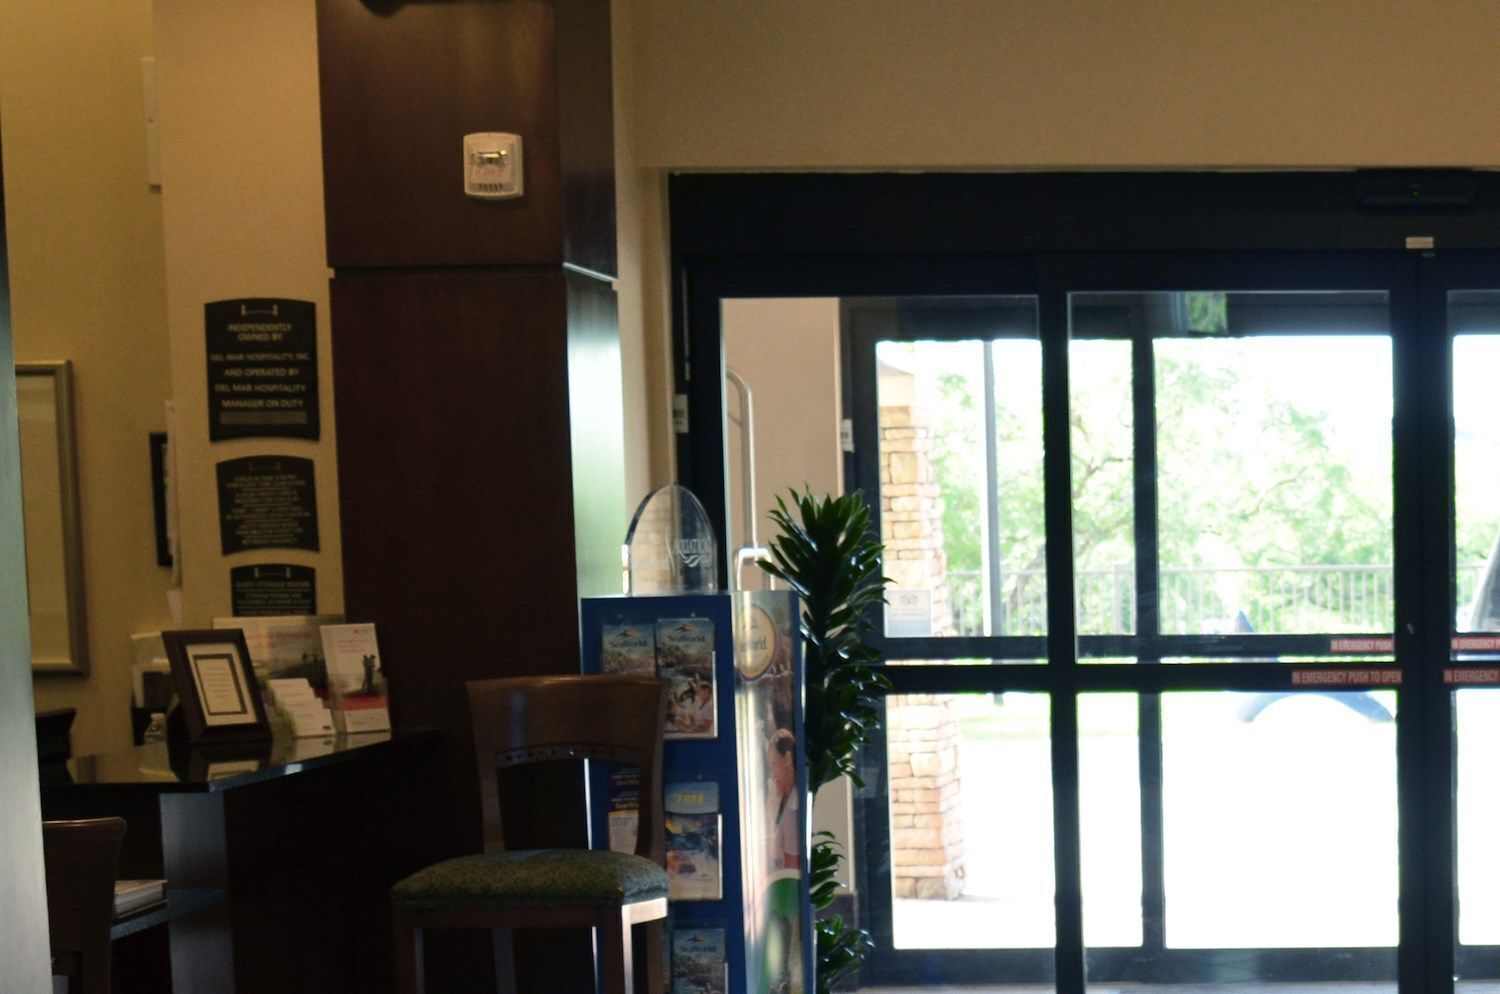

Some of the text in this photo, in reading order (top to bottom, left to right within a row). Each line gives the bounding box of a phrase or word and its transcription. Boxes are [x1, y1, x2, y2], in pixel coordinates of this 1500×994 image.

[227, 323, 292, 331] INDEPENDENTLY
[237, 332, 282, 341] OWNED BY
[224, 368, 299, 376] AND OPERATED BY
[254, 383, 306, 392] HOSPITALITY
[222, 399, 303, 408] MANAGER ON DUTY
[609, 639, 647, 648] SeaWorld
[1292, 671, 1402, 684] IN EMERGENCY PUSH TO OPEN
[1444, 670, 1452, 683] IN
[1454, 670, 1499, 683] EMERGENCY
